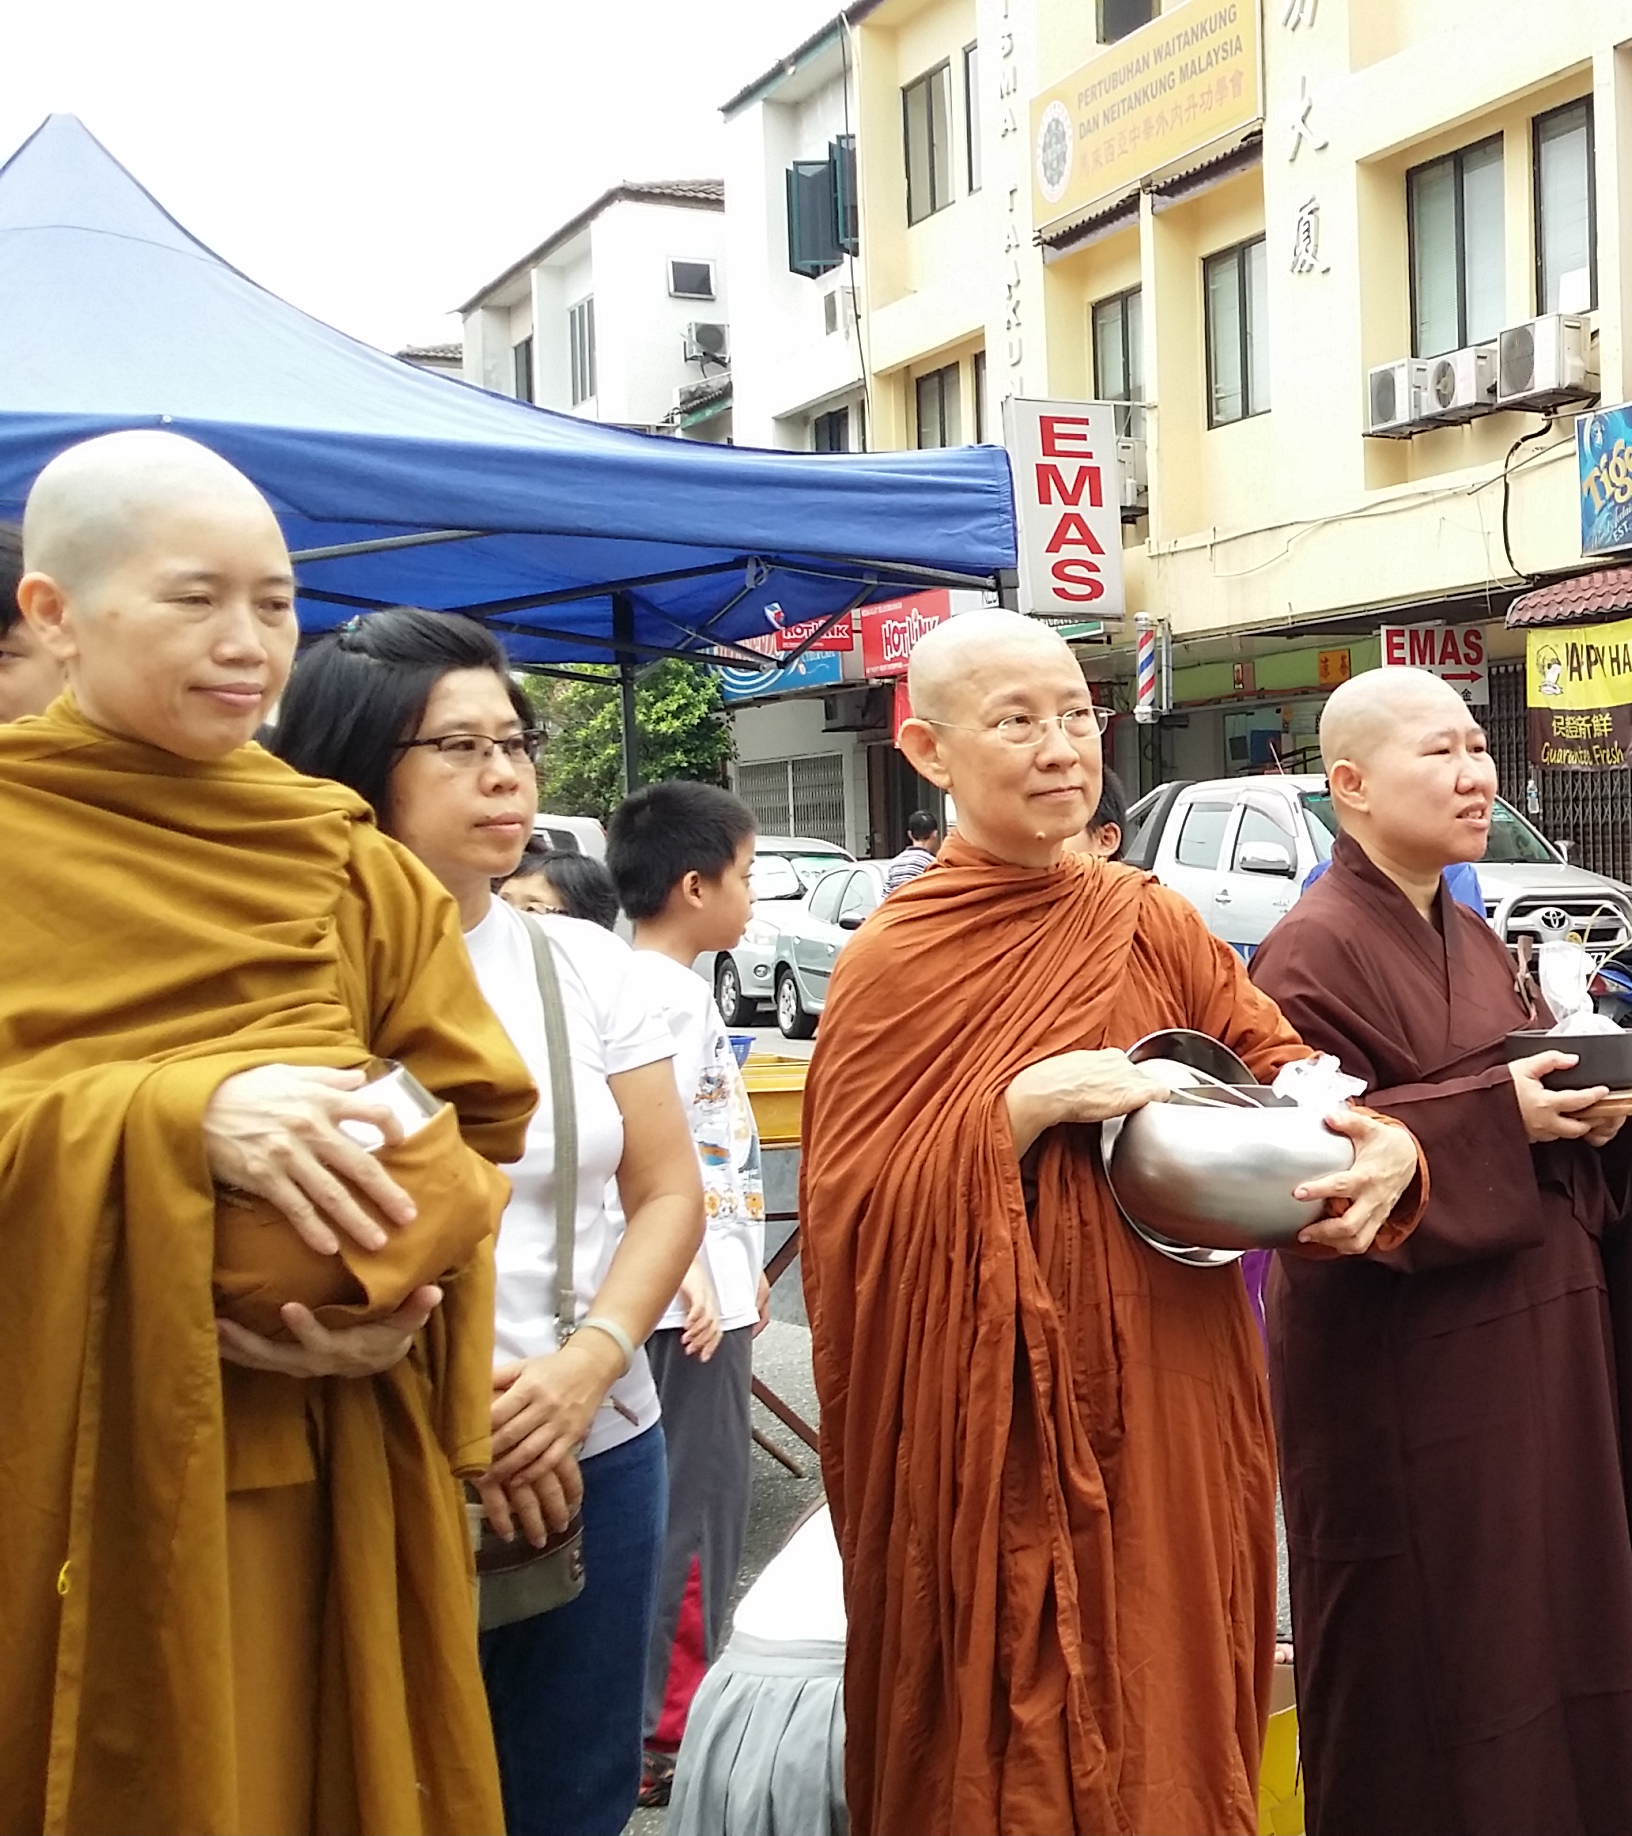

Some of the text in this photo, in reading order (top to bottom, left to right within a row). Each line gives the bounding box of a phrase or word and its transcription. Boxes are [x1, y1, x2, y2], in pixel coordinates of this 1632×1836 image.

[1078, 3, 1238, 110] PERTUBUHAN WAITANKUNG
[1079, 34, 1243, 140] DAN NEITANKUNG MALAYSIA
[1034, 414, 1106, 602] EMAS
[1385, 628, 1484, 667] EMAS
[1592, 740, 1624, 766] Fresh
